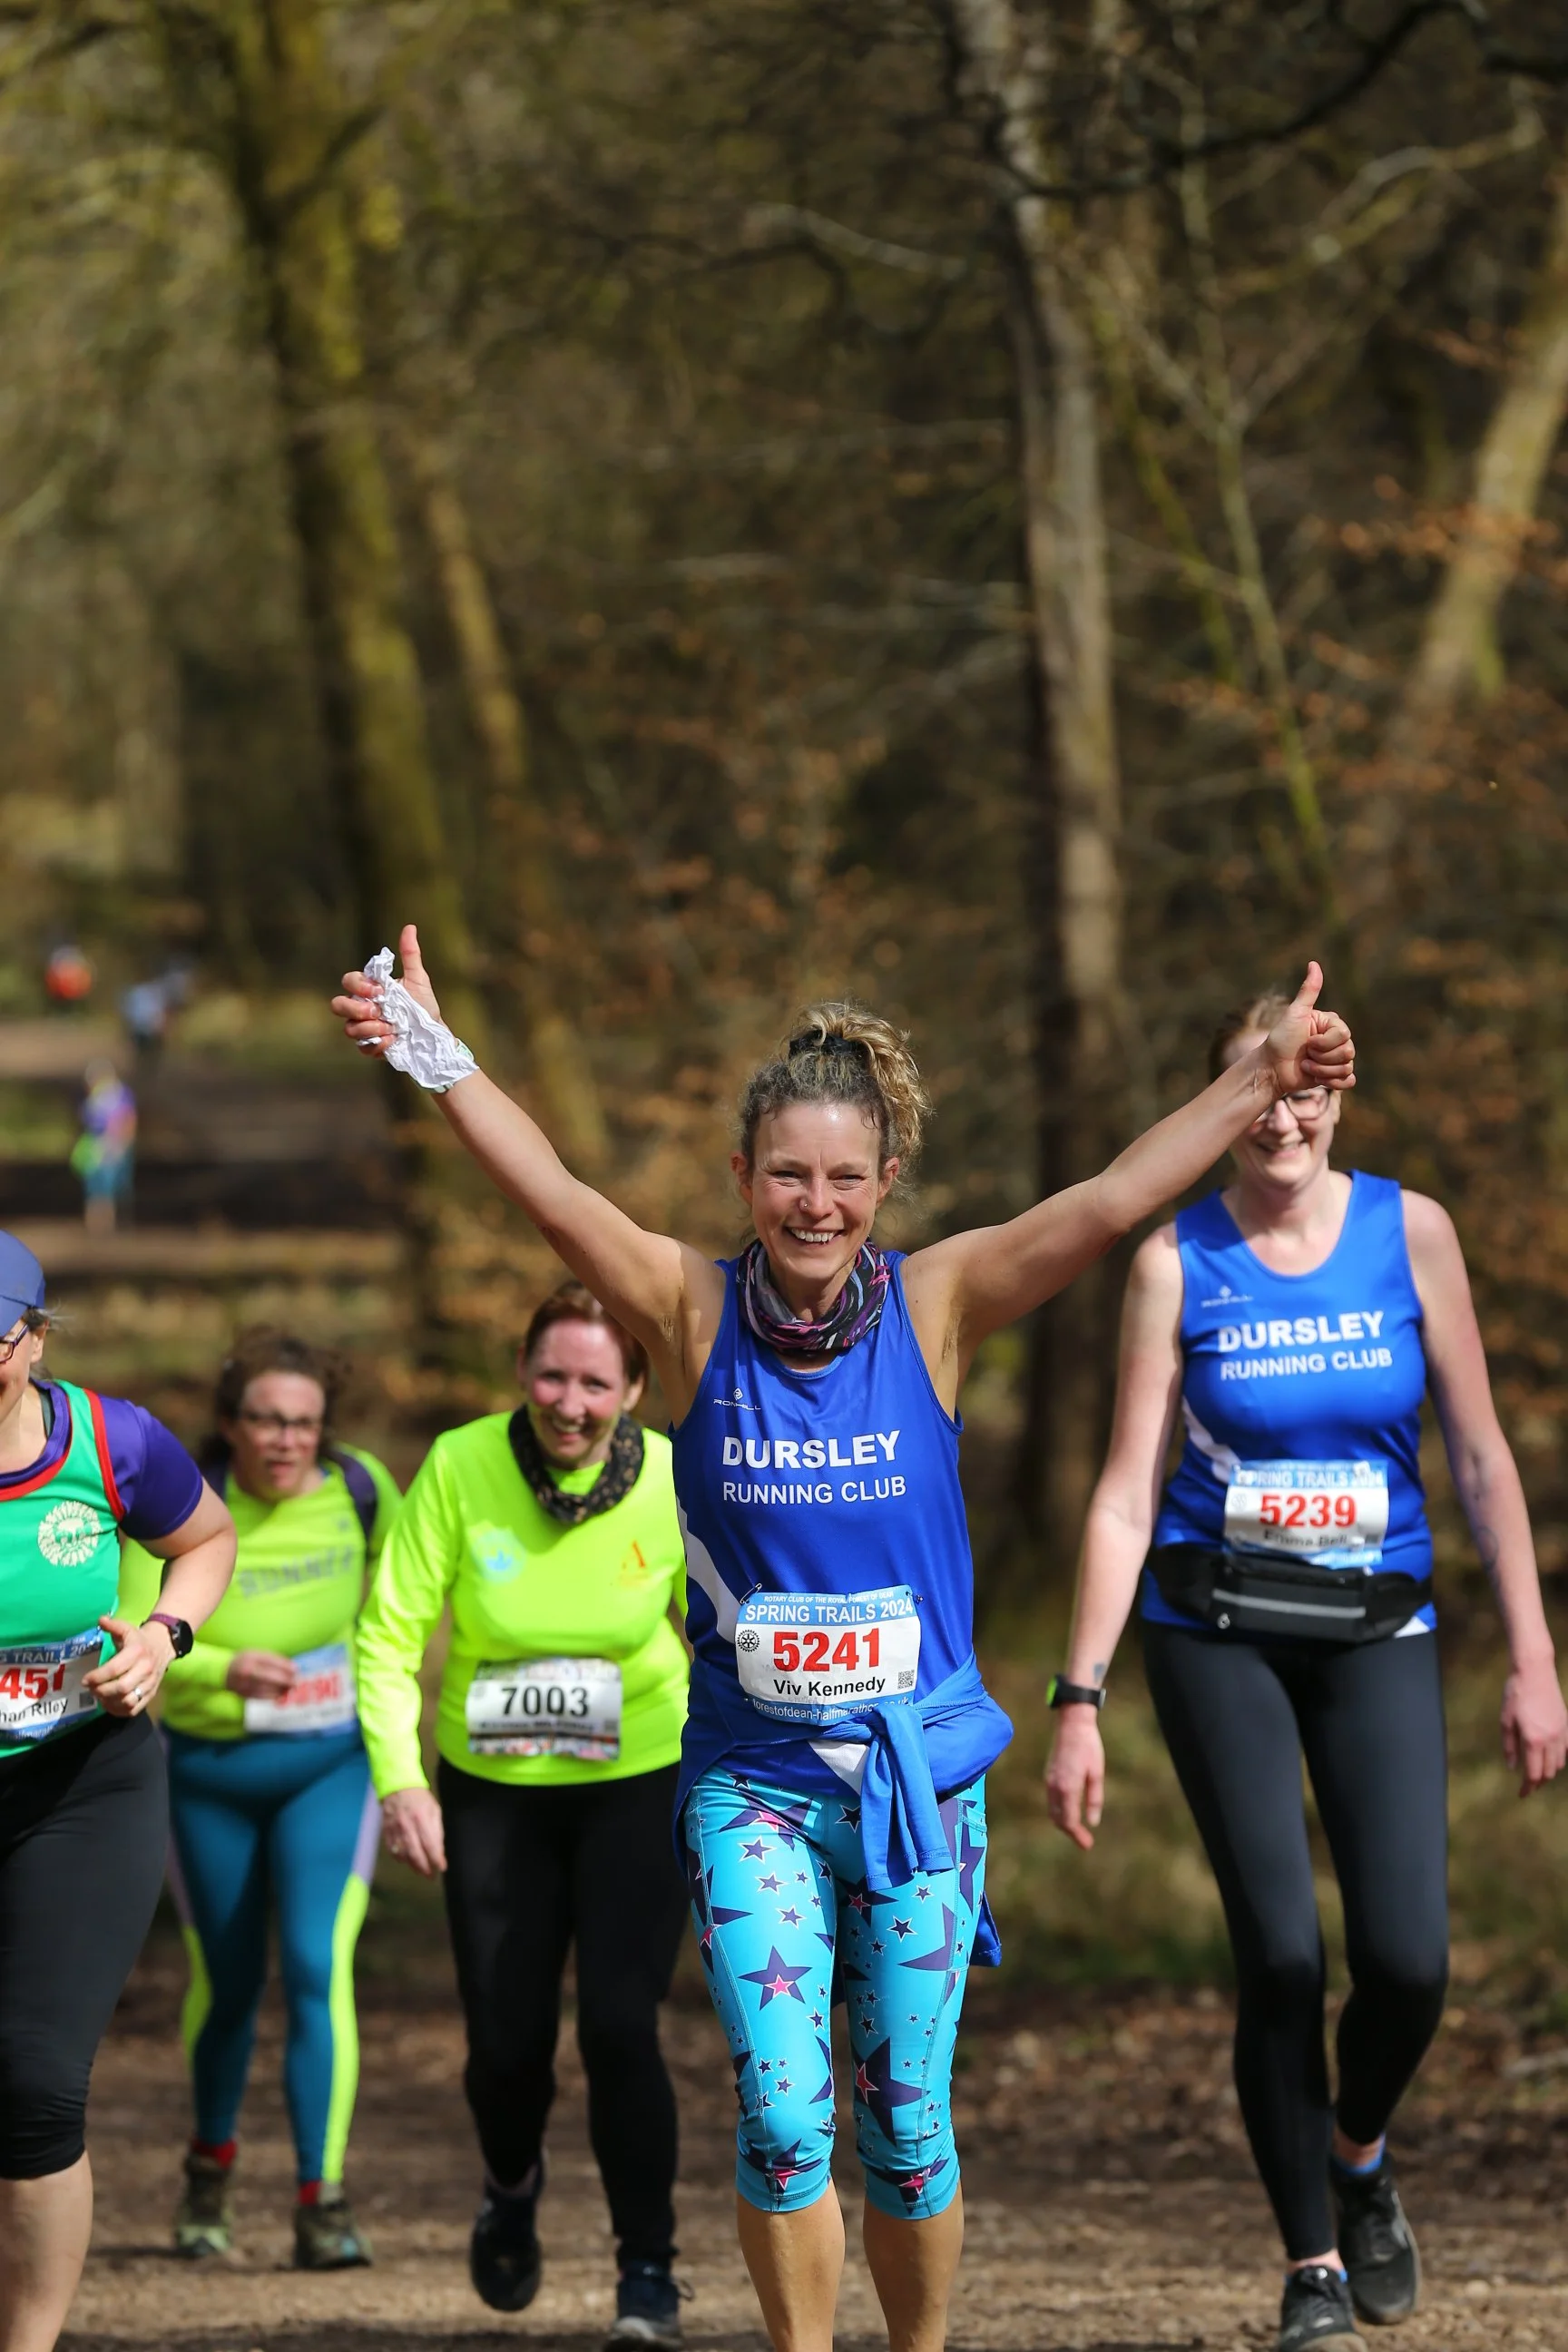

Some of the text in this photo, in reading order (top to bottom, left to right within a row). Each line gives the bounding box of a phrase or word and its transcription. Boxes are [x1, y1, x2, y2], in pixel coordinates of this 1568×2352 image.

[1218, 1310, 1384, 1353] DURSLEY
[1220, 1348, 1393, 1380] RUNNING CLUB
[722, 1429, 901, 1470] DURSLEY
[722, 1475, 906, 1504] RUNNING CLUB
[1259, 1494, 1358, 1529] 5239
[745, 1598, 914, 1623] SPRING TRAILS 2024
[828, 1596, 848, 1604] ROYAL
[773, 1628, 879, 1672] 5241
[501, 1686, 589, 1718] 7003
[773, 1677, 886, 1696] Viv Kennedy
